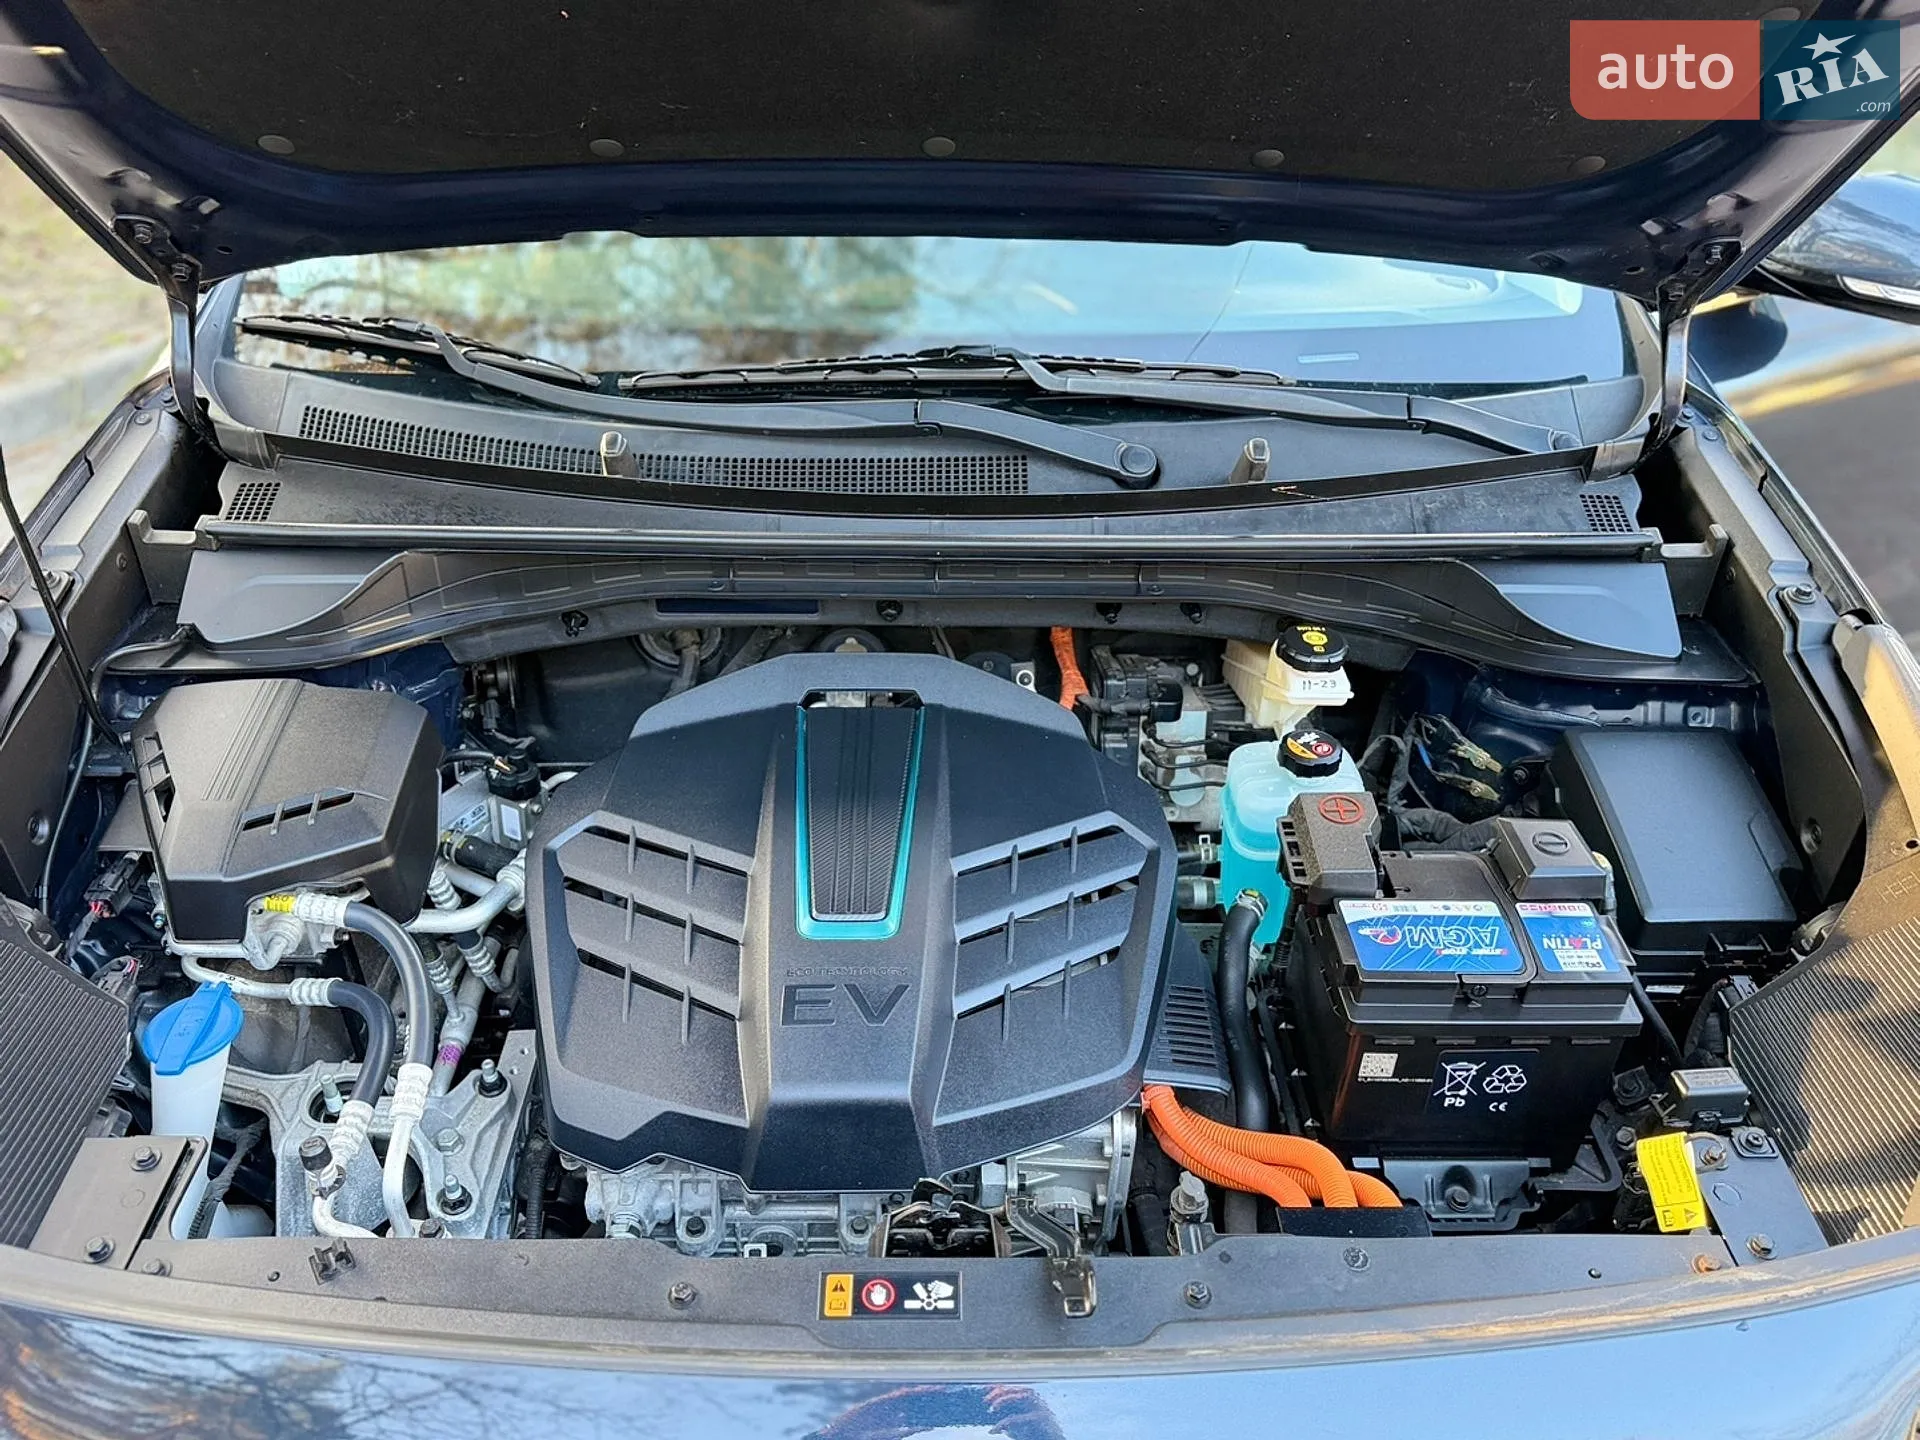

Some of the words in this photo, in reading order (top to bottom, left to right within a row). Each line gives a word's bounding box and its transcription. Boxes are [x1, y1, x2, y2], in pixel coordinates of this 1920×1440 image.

[1405, 925, 1500, 950] AGM
[1542, 936, 1603, 950] PLATIN
[780, 983, 912, 1027] EV
[1443, 1096, 1466, 1108] Pb
